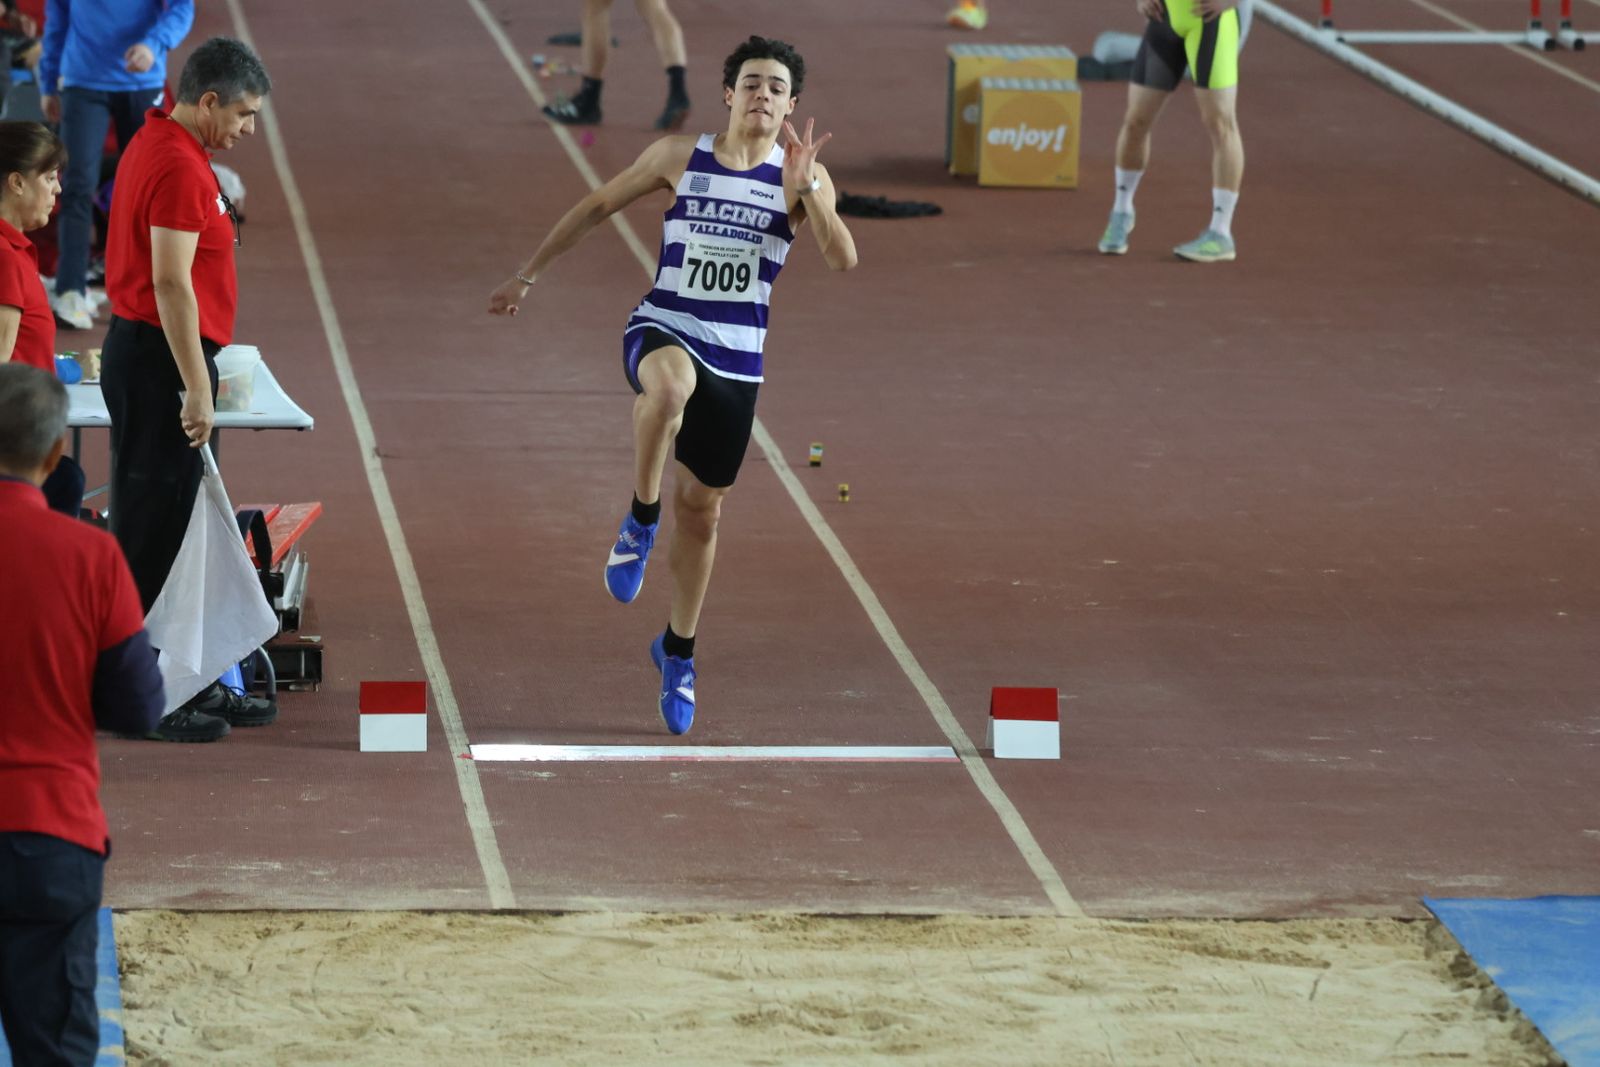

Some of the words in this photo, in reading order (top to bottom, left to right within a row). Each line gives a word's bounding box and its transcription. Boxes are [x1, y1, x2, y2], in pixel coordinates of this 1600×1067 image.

[987, 123, 1067, 153] enjoy!
[685, 199, 773, 229] RACING
[689, 223, 763, 244] VALLADOLID
[687, 257, 751, 293] 7009
